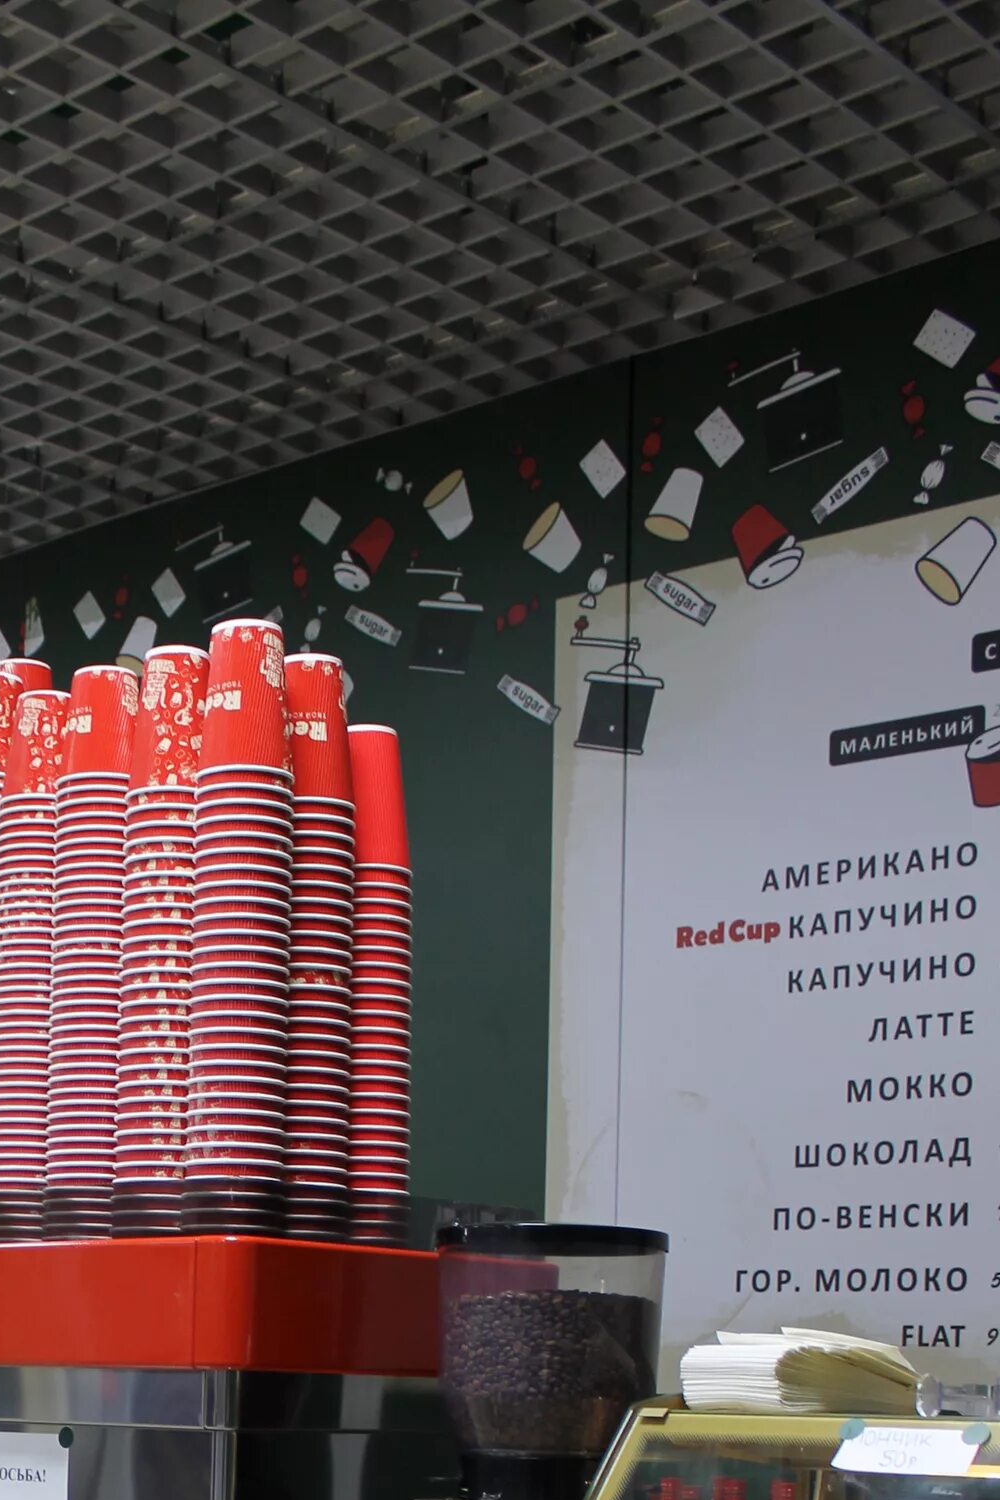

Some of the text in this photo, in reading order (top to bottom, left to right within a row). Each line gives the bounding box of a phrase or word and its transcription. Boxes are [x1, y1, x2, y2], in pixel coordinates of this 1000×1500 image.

[829, 465, 870, 506] sugar
[662, 581, 698, 613] sugar
[359, 612, 389, 637] sugar
[511, 684, 545, 714] sugar
[66, 714, 92, 733] Re
[839, 715, 975, 756] МАЛЕНЬКИЙ
[761, 842, 978, 893] АМЕРИКАНО
[675, 895, 977, 949] Red Cup КАПУЧИНО
[787, 952, 976, 993] КАПУЧИНО
[868, 1010, 974, 1042] ЛАТТЕ
[847, 1071, 973, 1103] МОККО
[795, 1137, 972, 1168] ШОКОЛАД
[773, 1202, 969, 1231] ПО-ВЕНСКИ
[735, 1269, 800, 1293] ГОР.
[815, 1267, 968, 1293] МОЛОКО
[901, 1325, 966, 1348] FLAT
